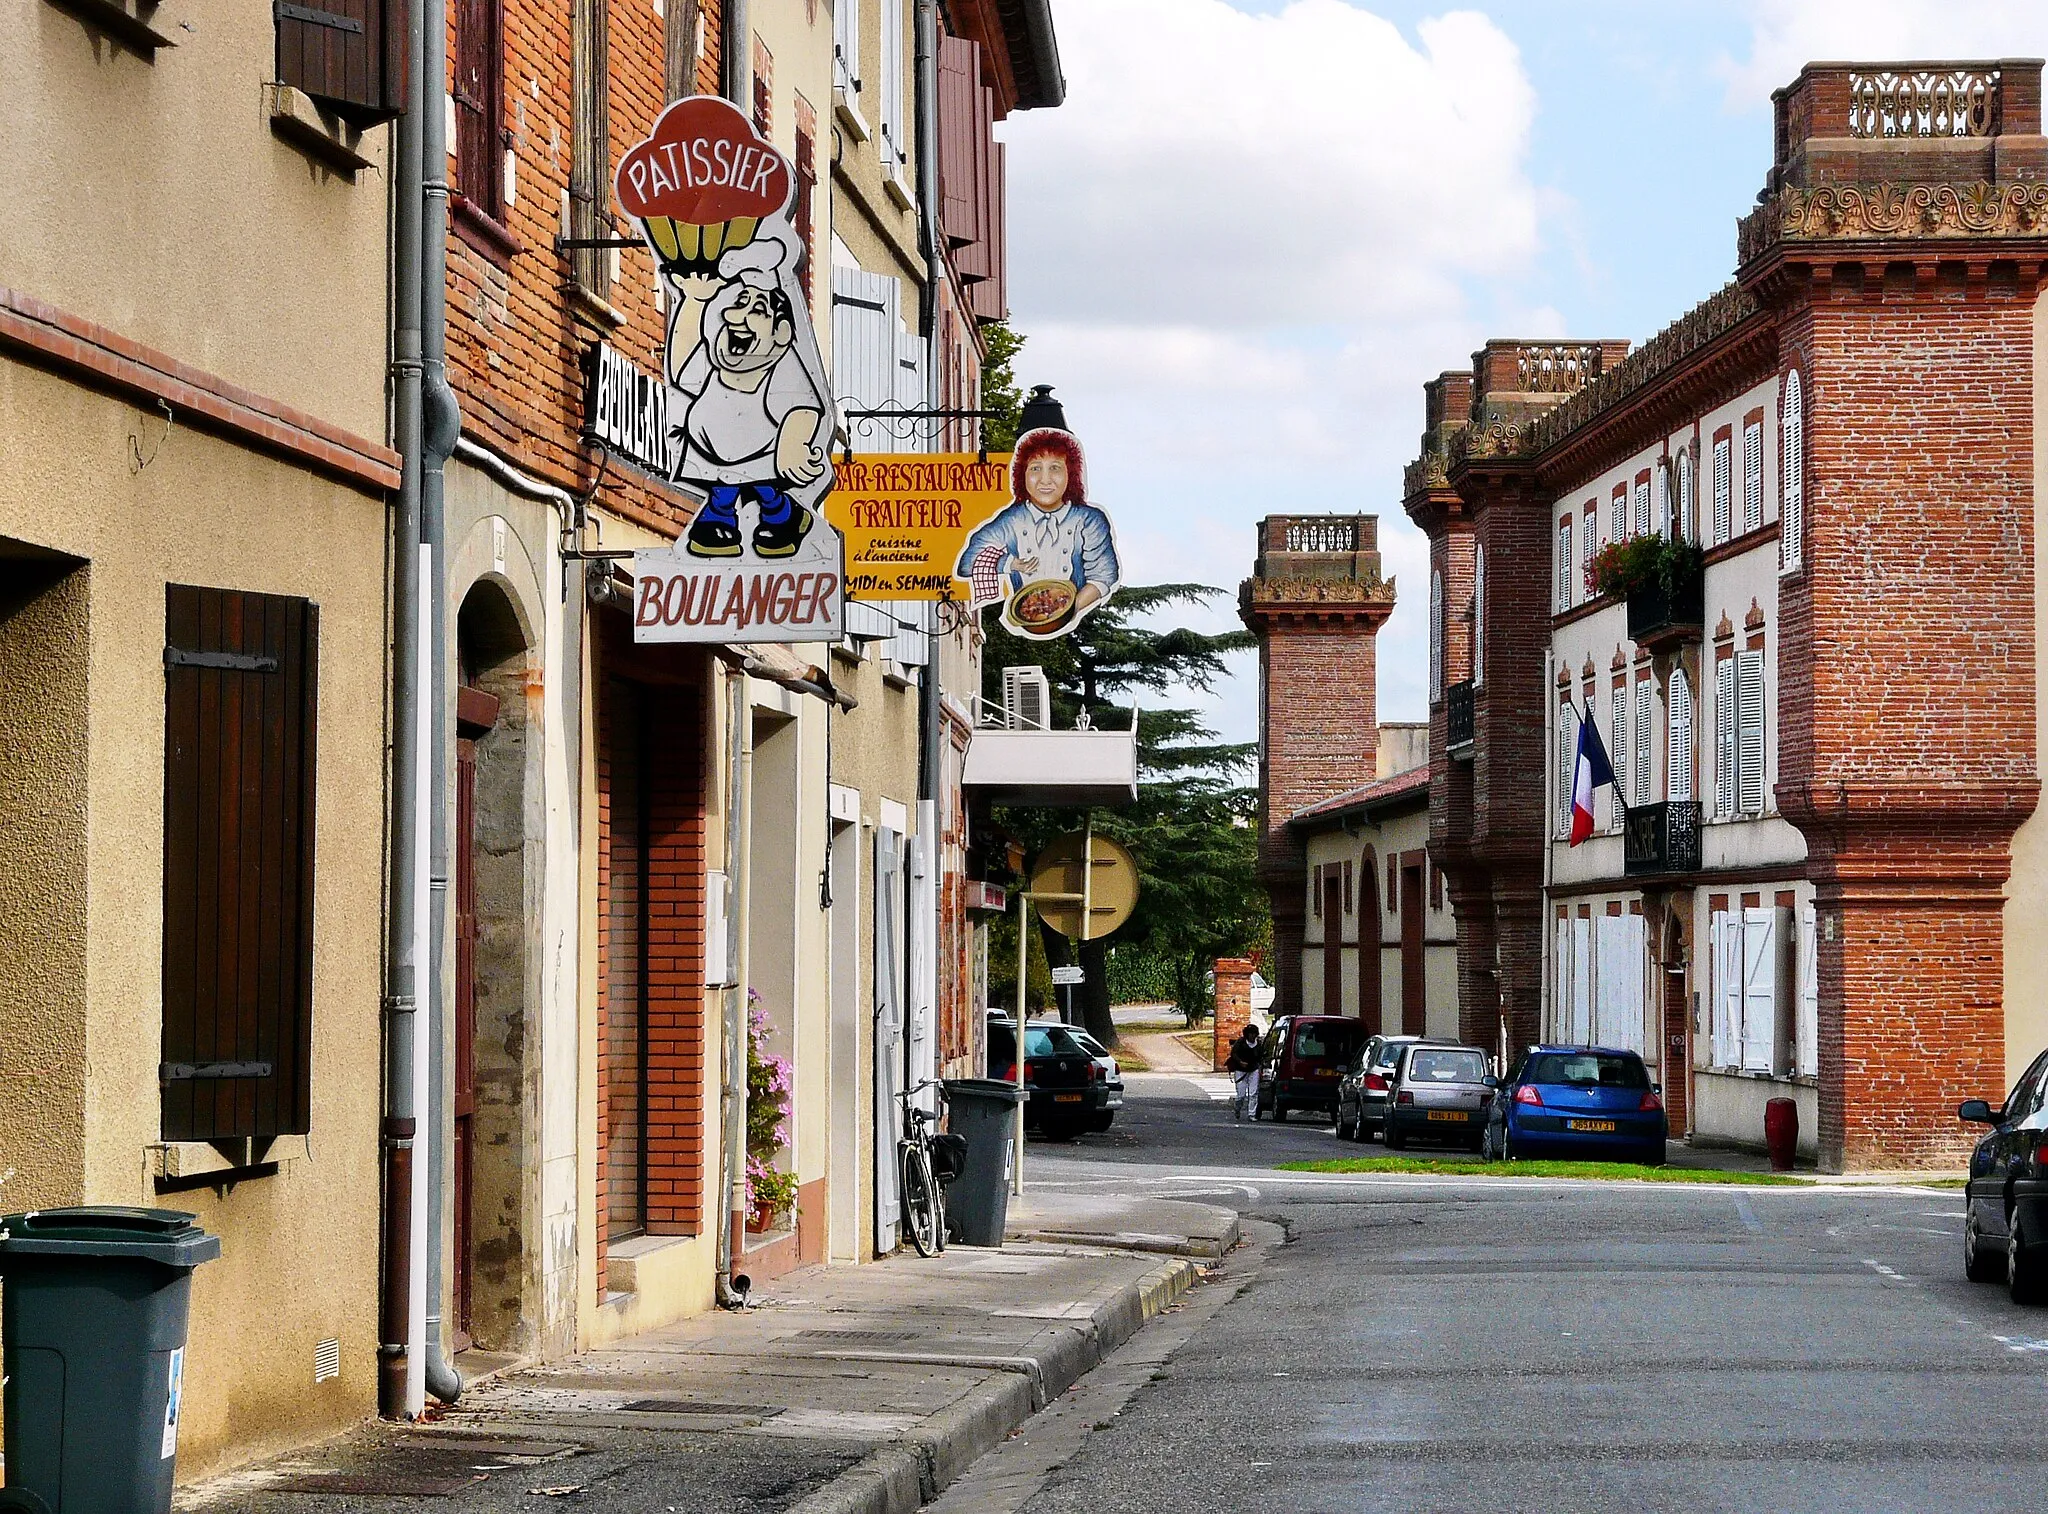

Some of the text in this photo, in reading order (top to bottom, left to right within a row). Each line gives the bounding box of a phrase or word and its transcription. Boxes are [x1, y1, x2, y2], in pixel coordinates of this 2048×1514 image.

[627, 137, 780, 204] PATISSIER
[849, 499, 963, 528] TRAITEUR
[869, 534, 922, 549] cuisine
[845, 574, 878, 591] MIDI
[896, 574, 952, 591] SEMAINE
[635, 572, 838, 630] BOULANGER
